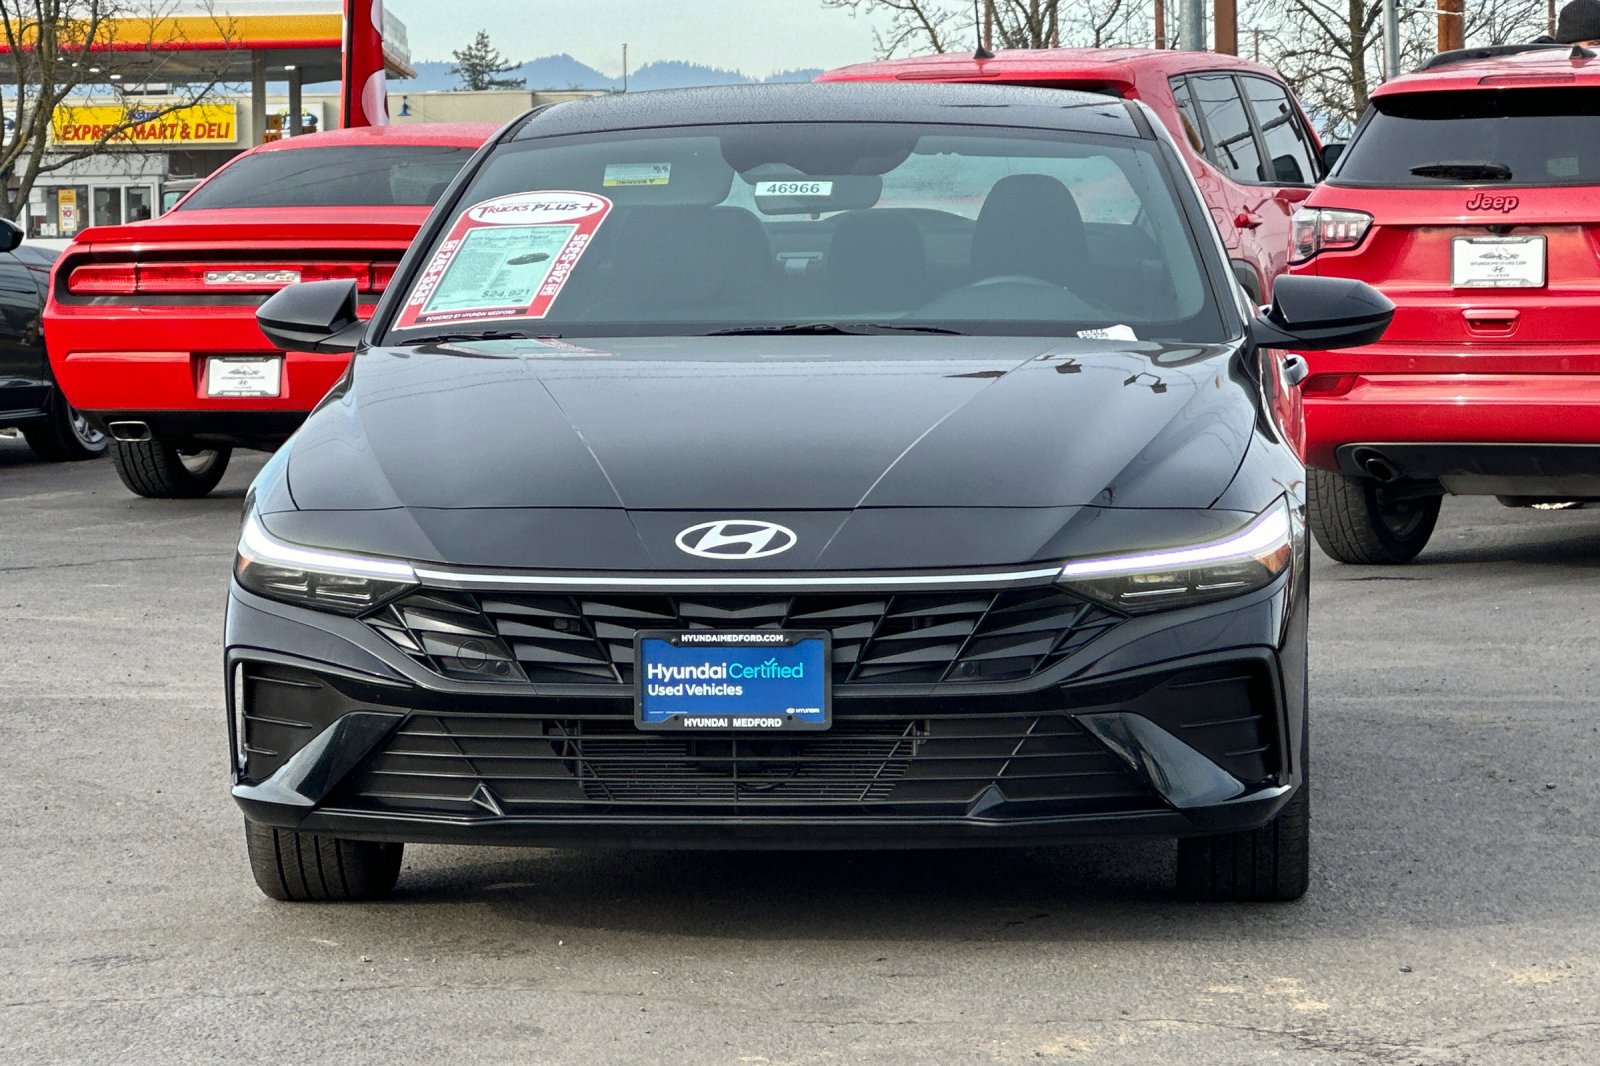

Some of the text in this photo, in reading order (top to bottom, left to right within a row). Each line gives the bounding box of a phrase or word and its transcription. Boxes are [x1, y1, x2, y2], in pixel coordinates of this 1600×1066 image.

[131, 123, 177, 139] MART
[179, 123, 191, 139] &
[194, 122, 231, 139] DELI
[766, 183, 820, 193] 46966
[1466, 193, 1519, 214] Jeep
[547, 233, 590, 283] 245-5335
[410, 251, 453, 306] 245-5335
[681, 634, 784, 643] HYUNDAIMEDFORD.COM
[647, 658, 804, 682] Hyundai Certified
[648, 683, 743, 696] Used Vehicles
[684, 718, 782, 728] HYUNDAI MEDFORD
